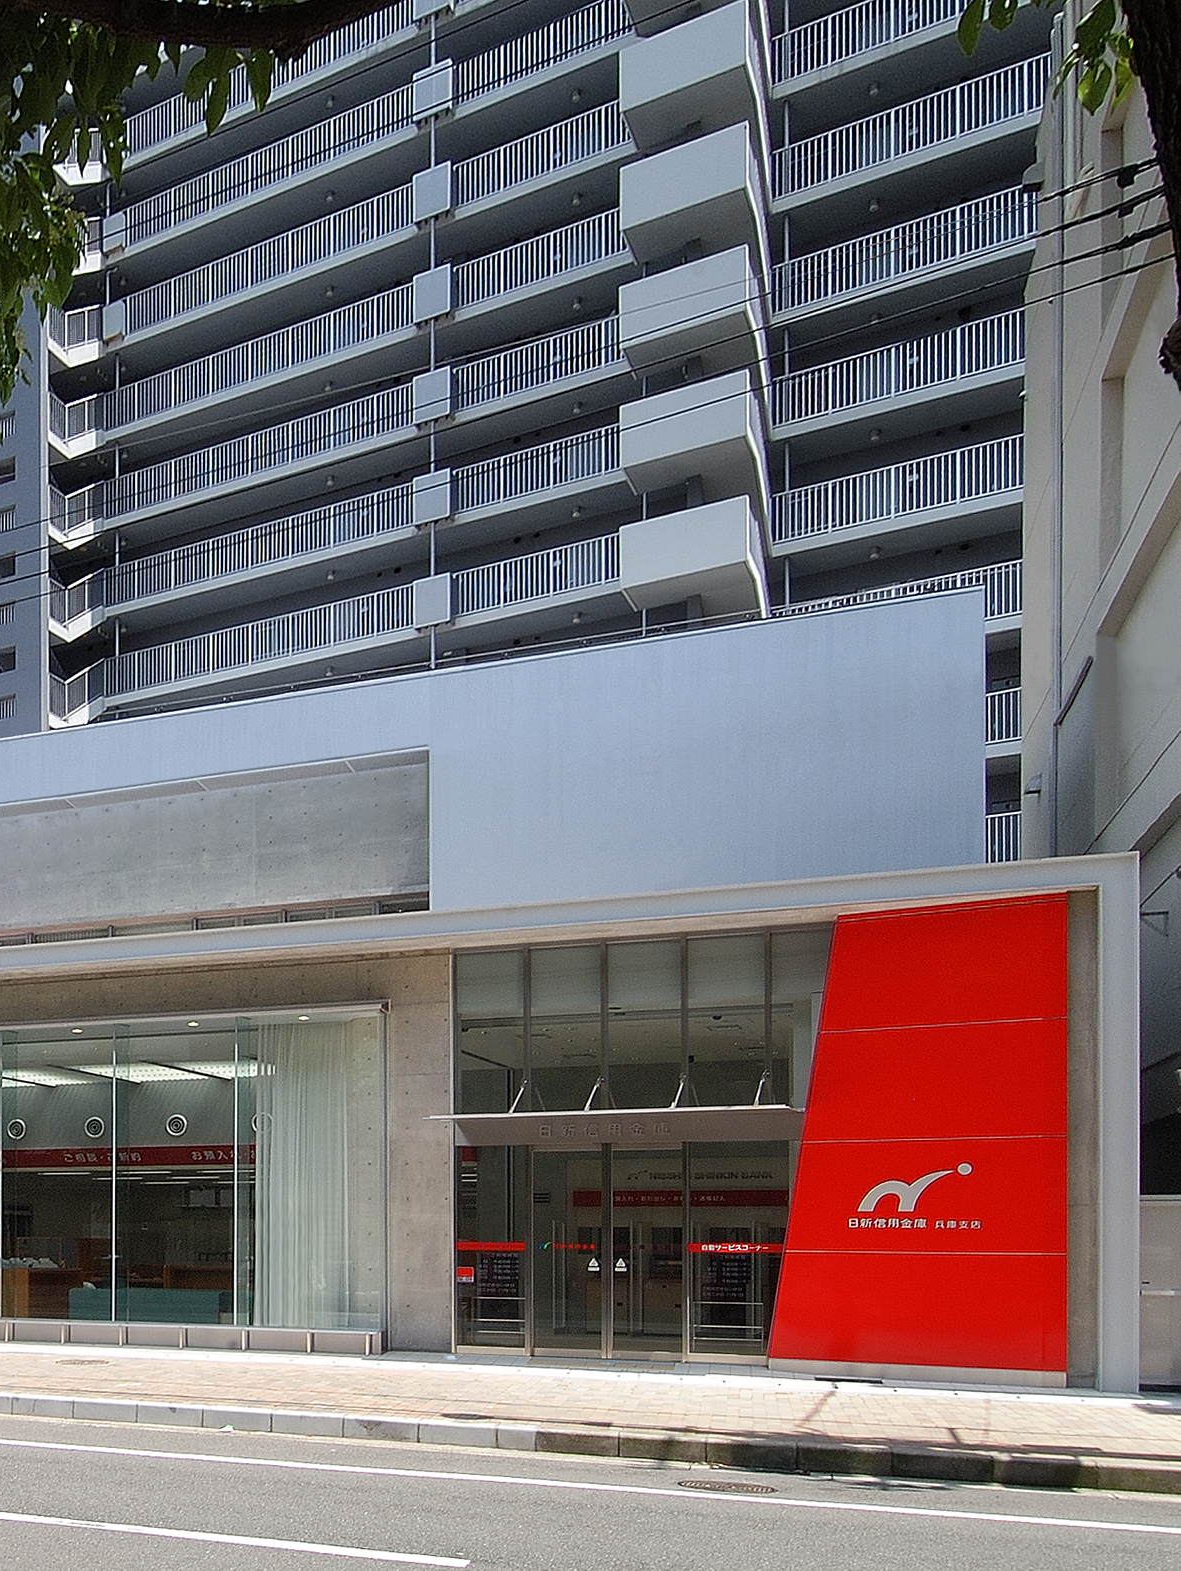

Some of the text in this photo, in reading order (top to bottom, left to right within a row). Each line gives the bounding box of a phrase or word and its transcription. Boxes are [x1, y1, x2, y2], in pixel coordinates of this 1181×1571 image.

[539, 1122, 670, 1138] 日新信用金庫
[848, 1218, 982, 1230] 日新信用金庫 兵庫支店
